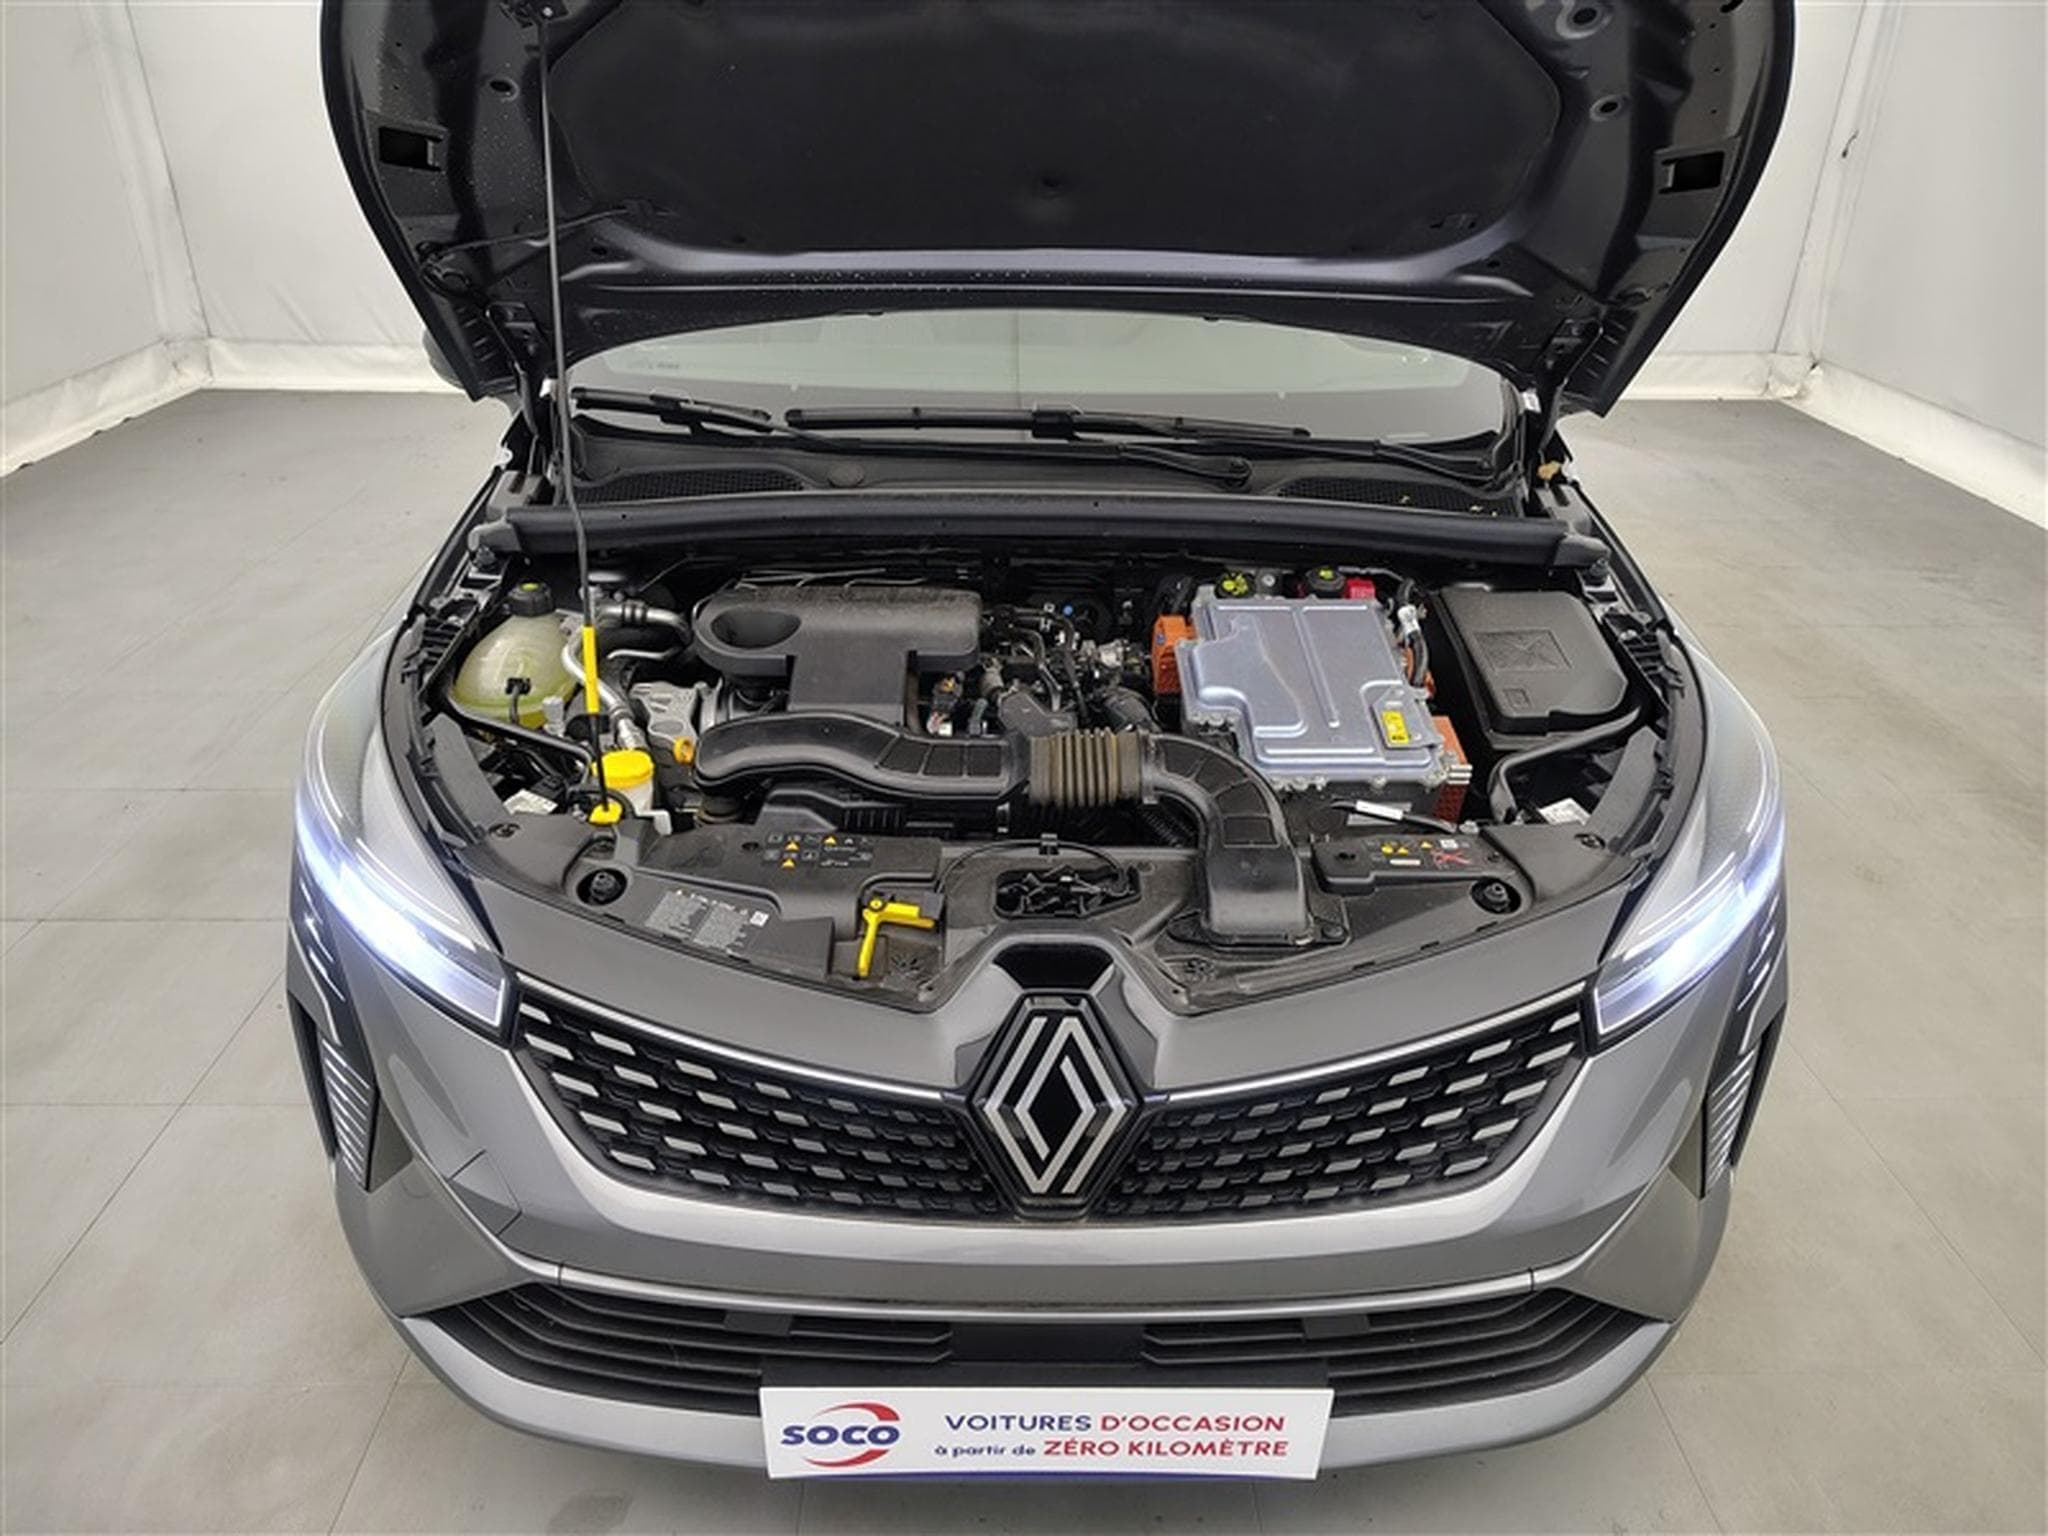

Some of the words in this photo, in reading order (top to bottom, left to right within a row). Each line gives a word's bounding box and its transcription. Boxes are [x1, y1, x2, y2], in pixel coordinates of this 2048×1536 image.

[945, 1415, 1092, 1431] VOITURES
[1100, 1415, 1285, 1432] D'OCCASION
[781, 1425, 900, 1445] SOCO
[935, 1445, 947, 1456] à
[952, 1445, 1005, 1458] partir
[1012, 1444, 1036, 1456] de
[1043, 1437, 1120, 1457] ZÉRO
[1126, 1438, 1289, 1457] KILOMÈTRE
